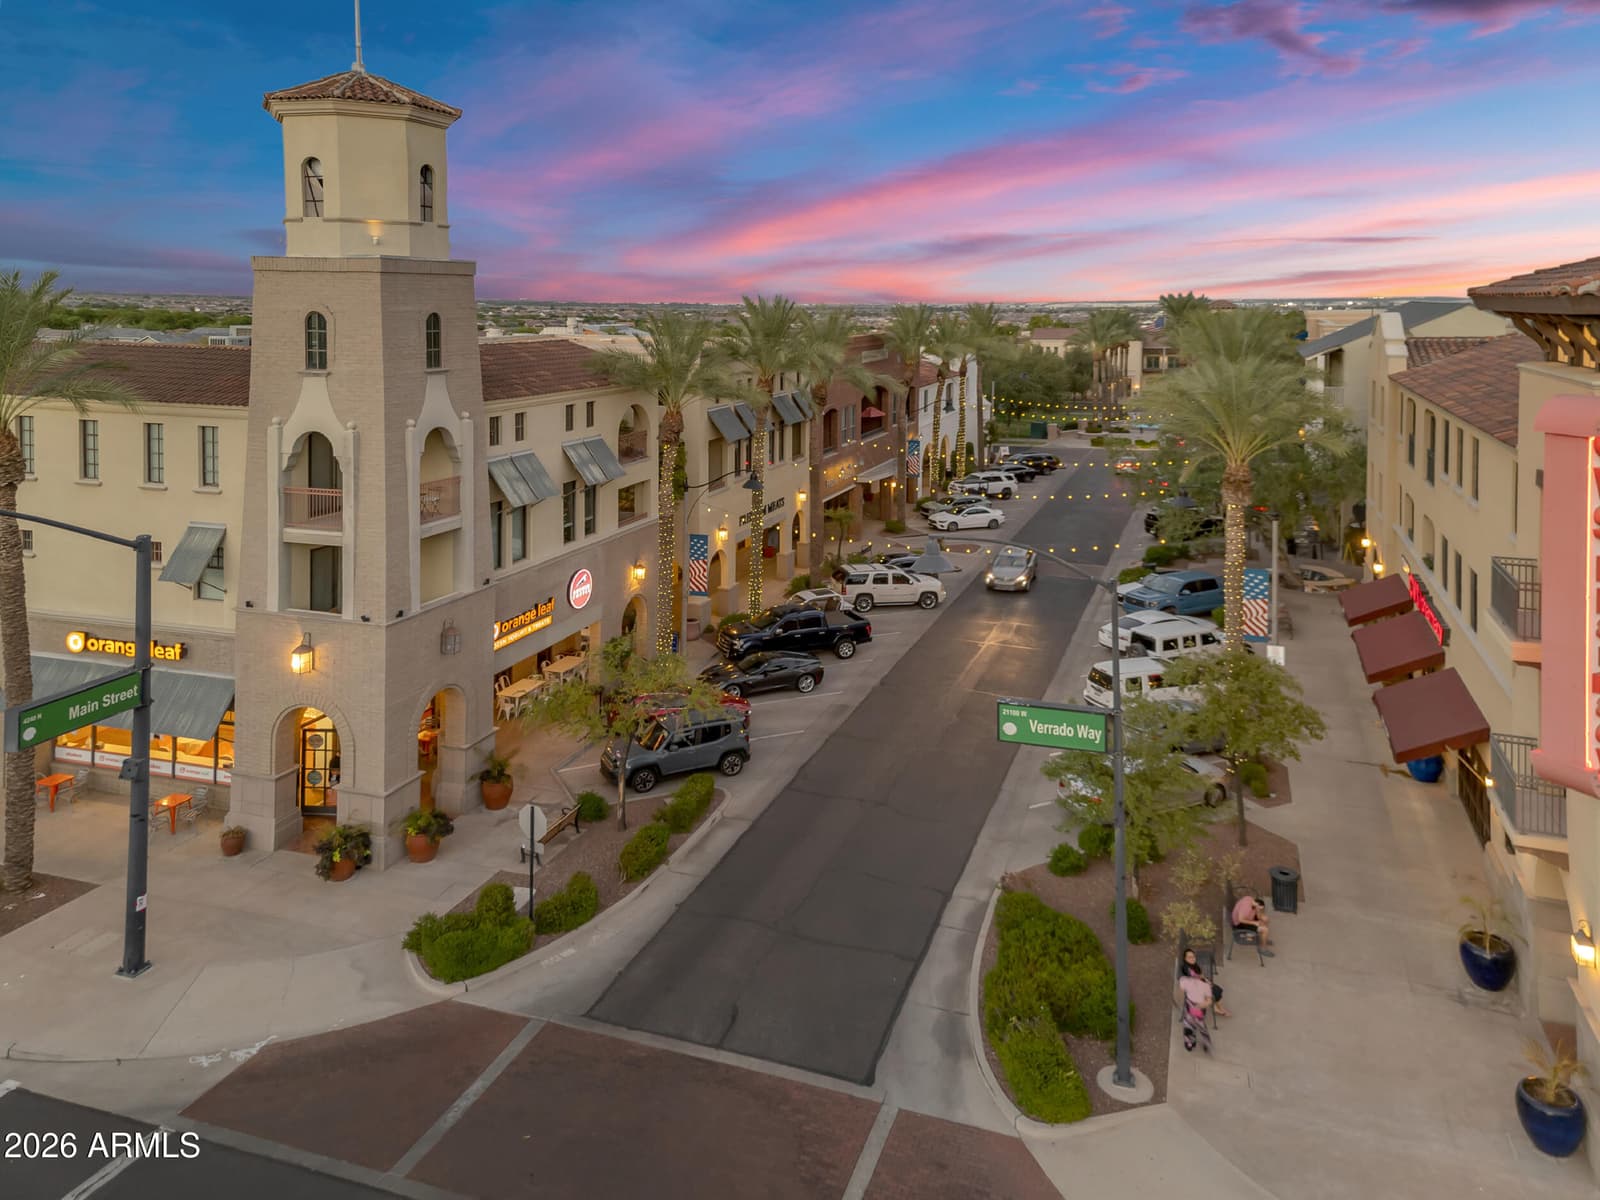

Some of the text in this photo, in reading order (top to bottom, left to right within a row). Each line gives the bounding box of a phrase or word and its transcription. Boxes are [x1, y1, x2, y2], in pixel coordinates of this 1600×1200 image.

[501, 596, 556, 633] orange leaf
[86, 637, 183, 661] orang leaf
[68, 685, 139, 721] Main Street
[1029, 719, 1102, 744] Verrado Way
